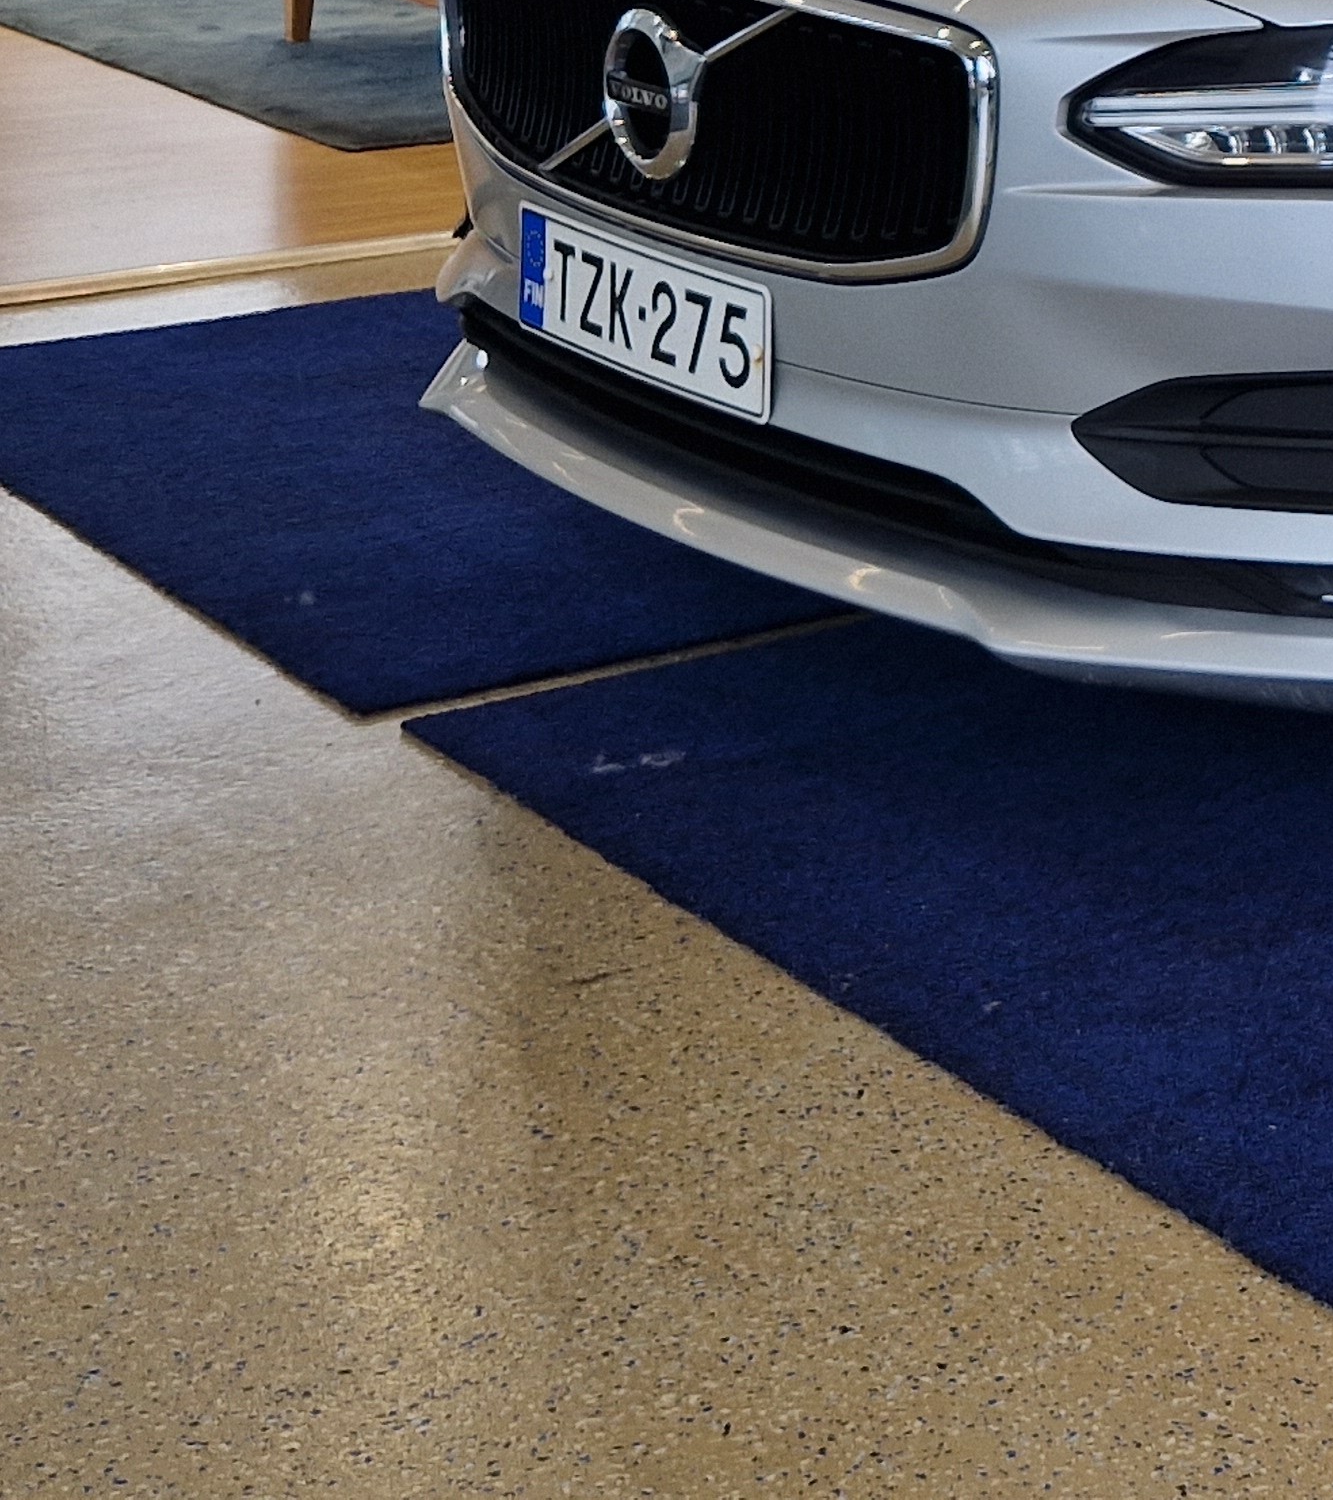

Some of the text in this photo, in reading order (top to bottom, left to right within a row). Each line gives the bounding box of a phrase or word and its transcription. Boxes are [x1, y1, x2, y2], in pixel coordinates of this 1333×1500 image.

[609, 80, 668, 110] VOLVO
[523, 278, 544, 309] FIN
[553, 238, 751, 389] TZK-275
